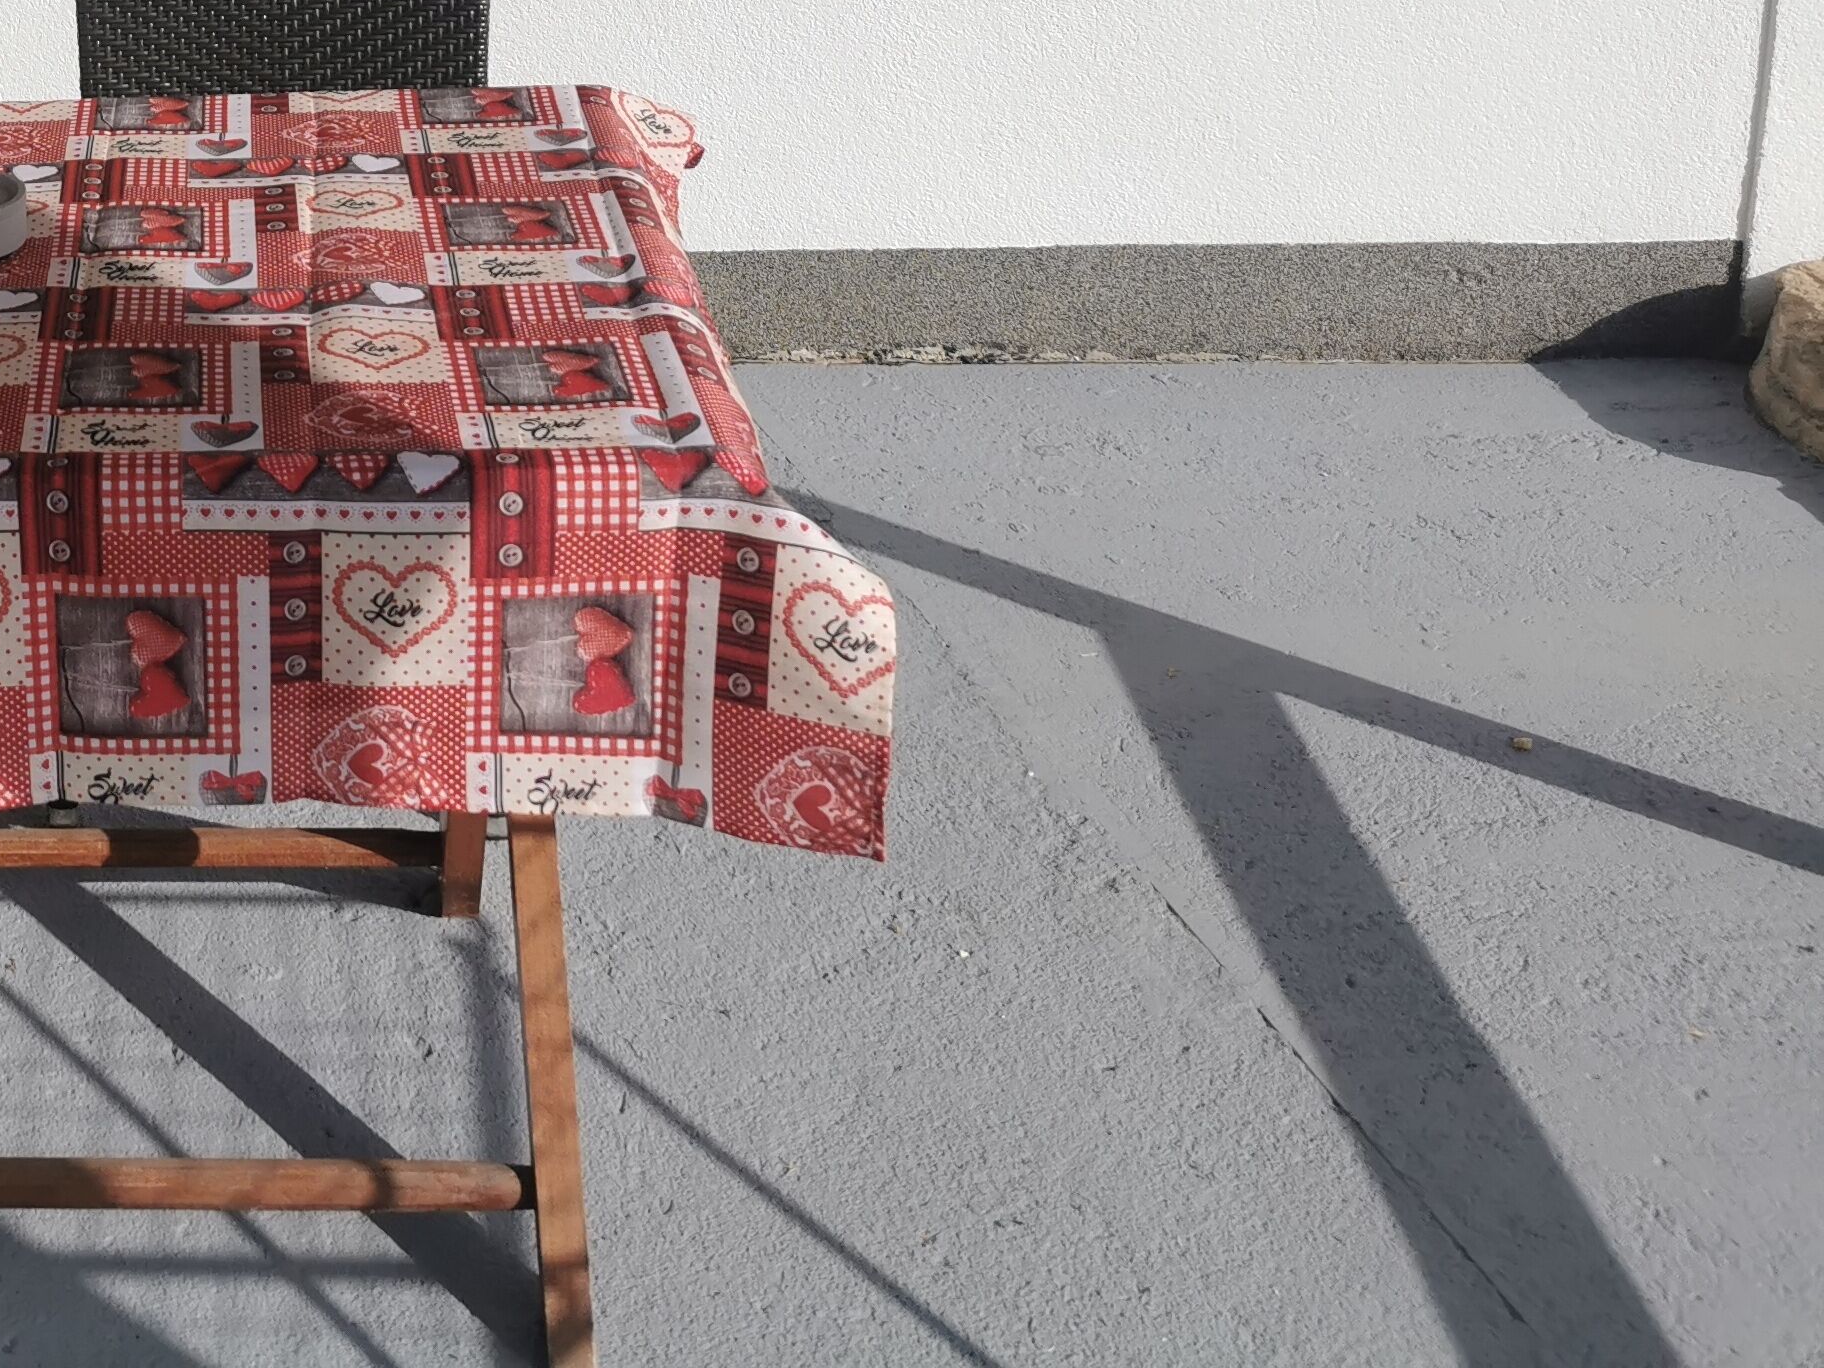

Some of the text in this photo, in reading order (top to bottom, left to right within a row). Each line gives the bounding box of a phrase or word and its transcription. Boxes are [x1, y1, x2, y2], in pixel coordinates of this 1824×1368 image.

[633, 109, 672, 135] Love
[363, 590, 424, 628] Love
[812, 616, 879, 663] Love
[87, 767, 160, 800] Sweet
[527, 768, 602, 805] Sweet
